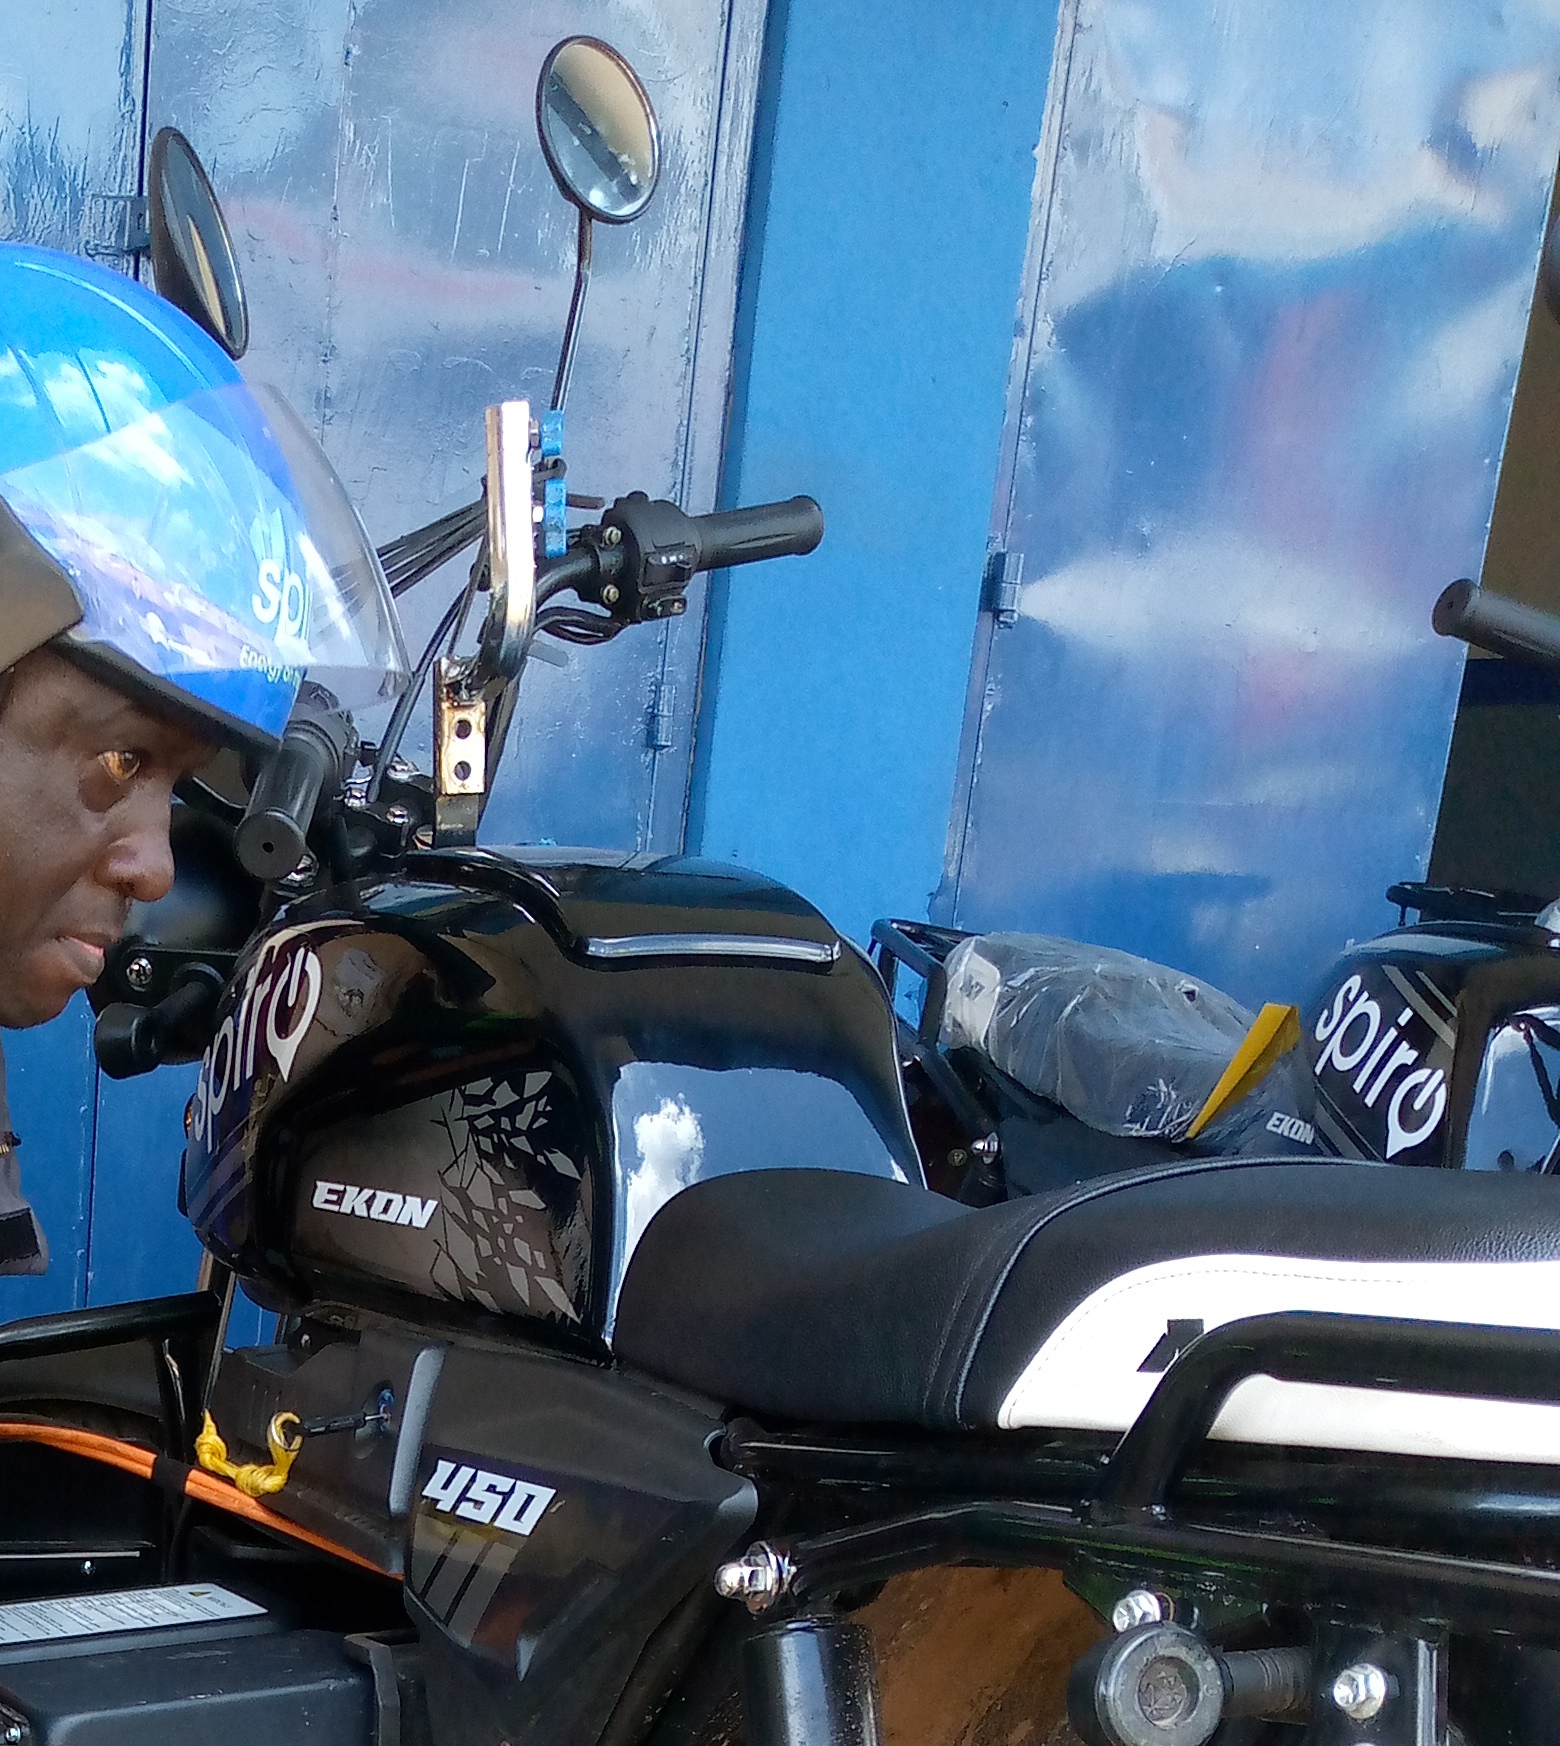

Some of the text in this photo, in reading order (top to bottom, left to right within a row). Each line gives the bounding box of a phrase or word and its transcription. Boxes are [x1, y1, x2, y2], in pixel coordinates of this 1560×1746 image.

[1314, 974, 1447, 1159] spiro
[1265, 1111, 1315, 1145] EKON
[312, 1180, 438, 1229] EKON
[421, 1459, 557, 1536] 450
